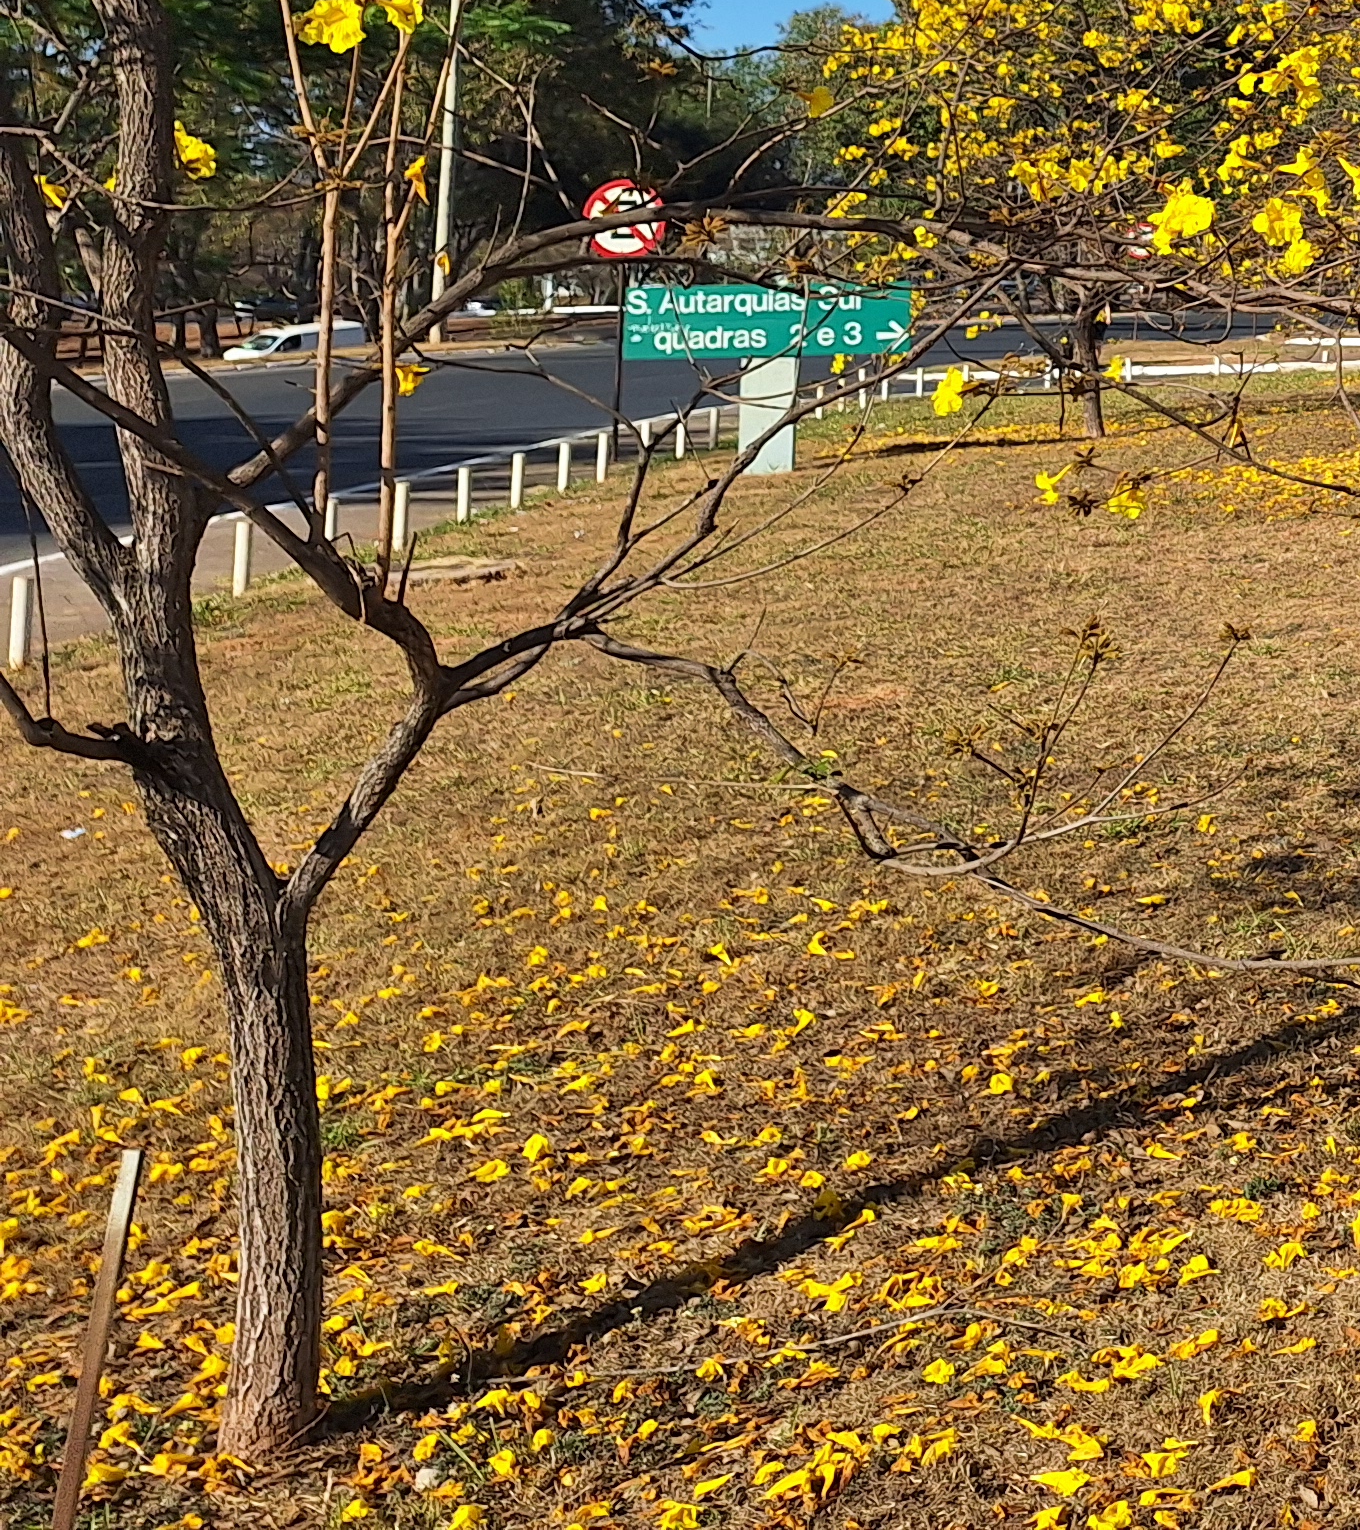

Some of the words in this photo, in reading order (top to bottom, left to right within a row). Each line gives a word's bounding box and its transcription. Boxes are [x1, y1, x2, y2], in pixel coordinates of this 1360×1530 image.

[658, 288, 806, 317] Autarquias
[817, 285, 862, 311] Sul
[653, 324, 767, 355] quadras
[789, 323, 808, 347] 2
[816, 326, 836, 347] e
[842, 321, 863, 346] 3
